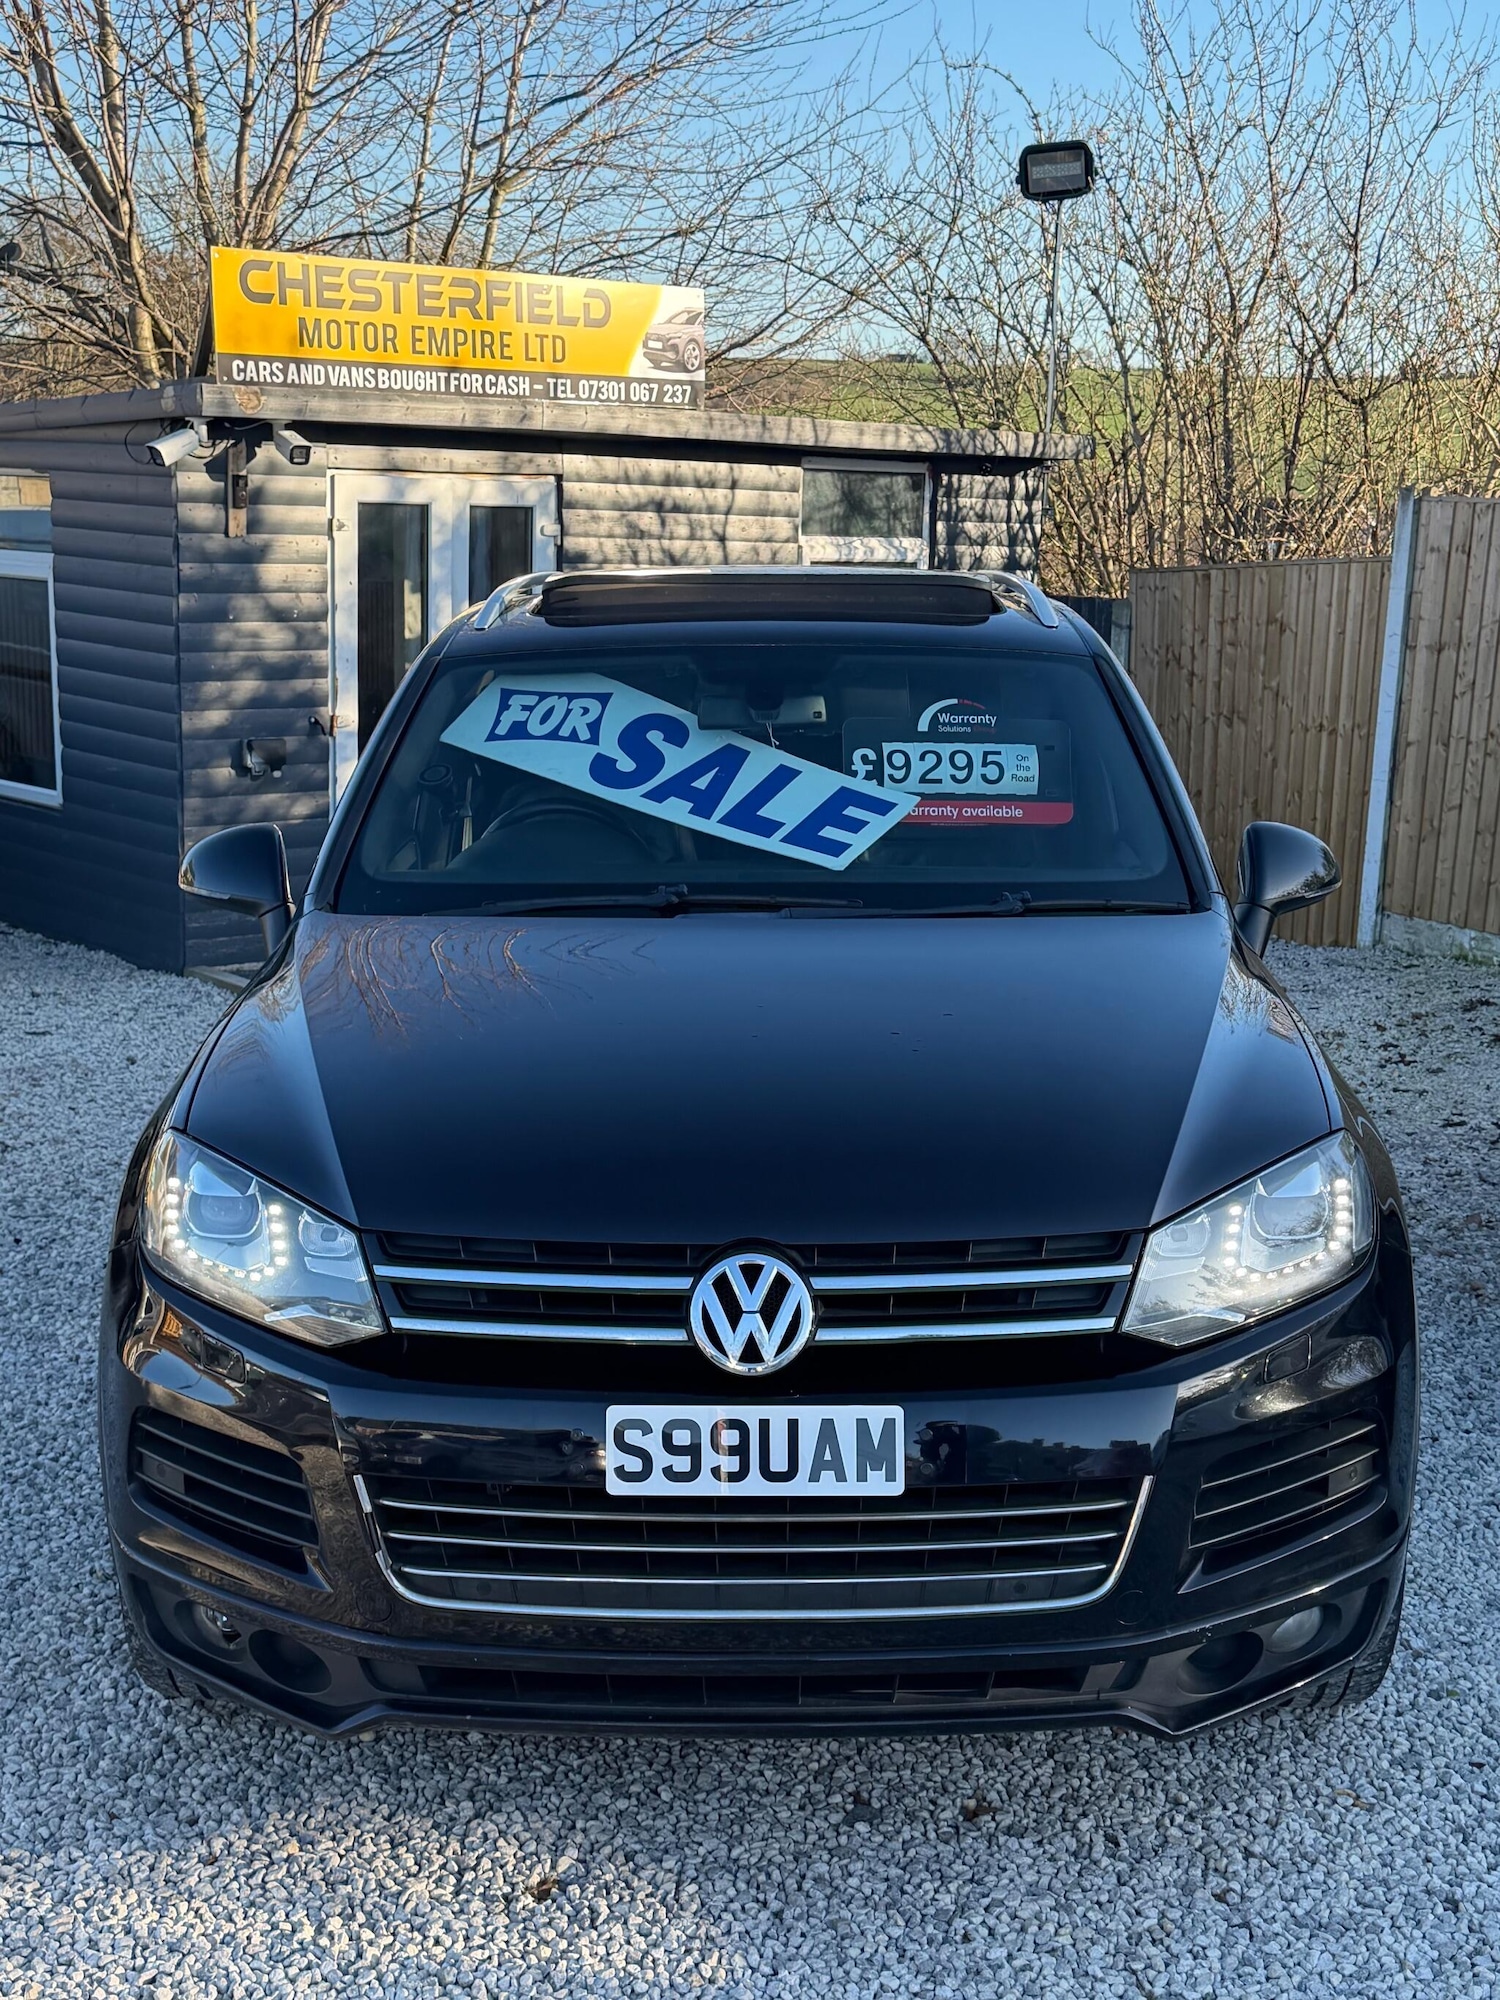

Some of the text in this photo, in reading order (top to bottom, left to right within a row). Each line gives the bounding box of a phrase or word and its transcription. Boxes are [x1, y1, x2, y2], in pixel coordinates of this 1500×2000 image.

[239, 259, 612, 329] CHESTERFIELD
[298, 316, 567, 364] MOTOR EMPIRE LTD
[232, 359, 284, 383] CARS
[287, 363, 325, 386] AND
[327, 365, 379, 389] VANS
[378, 368, 448, 392] BOUGHT
[450, 373, 483, 394] FOR
[484, 375, 530, 396] CASH
[578, 380, 625, 401] 07301
[630, 382, 658, 402] 067
[663, 384, 692, 404] 237
[938, 712, 997, 727] Warranty
[938, 724, 971, 733] Solutions
[851, 748, 1005, 786] £9295
[1016, 754, 1029, 762] On
[1016, 763, 1031, 772] the
[495, 694, 899, 858] FOR SALE
[1011, 773, 1035, 783] Road
[909, 805, 1023, 819] arranty available
[613, 1418, 897, 1483] S99UAM
